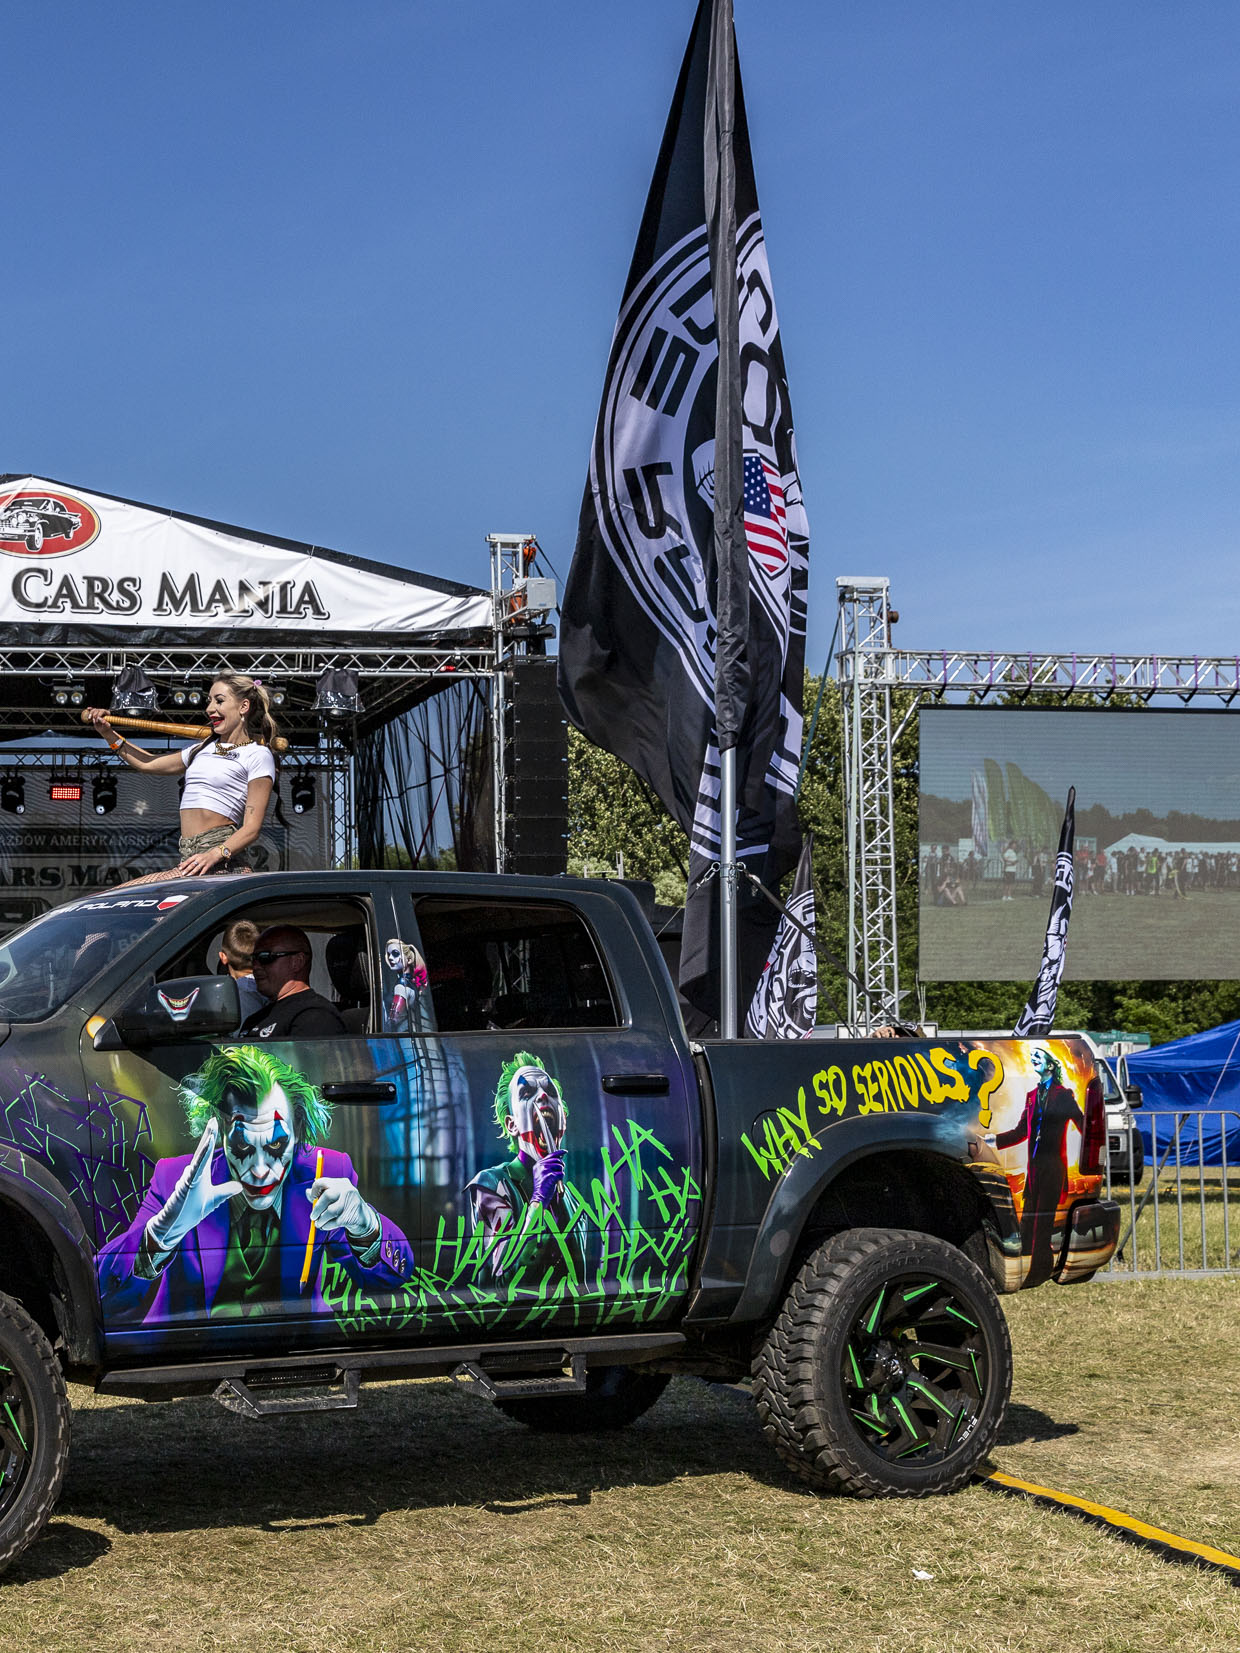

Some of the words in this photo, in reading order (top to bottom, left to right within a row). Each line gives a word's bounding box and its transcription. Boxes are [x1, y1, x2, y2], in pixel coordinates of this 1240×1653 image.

[11, 567, 142, 615] CARS
[152, 571, 331, 619] MANIA
[813, 1065, 847, 1116] SO
[741, 1086, 822, 1181] WHY
[957, 1416, 978, 1443] FUEL
